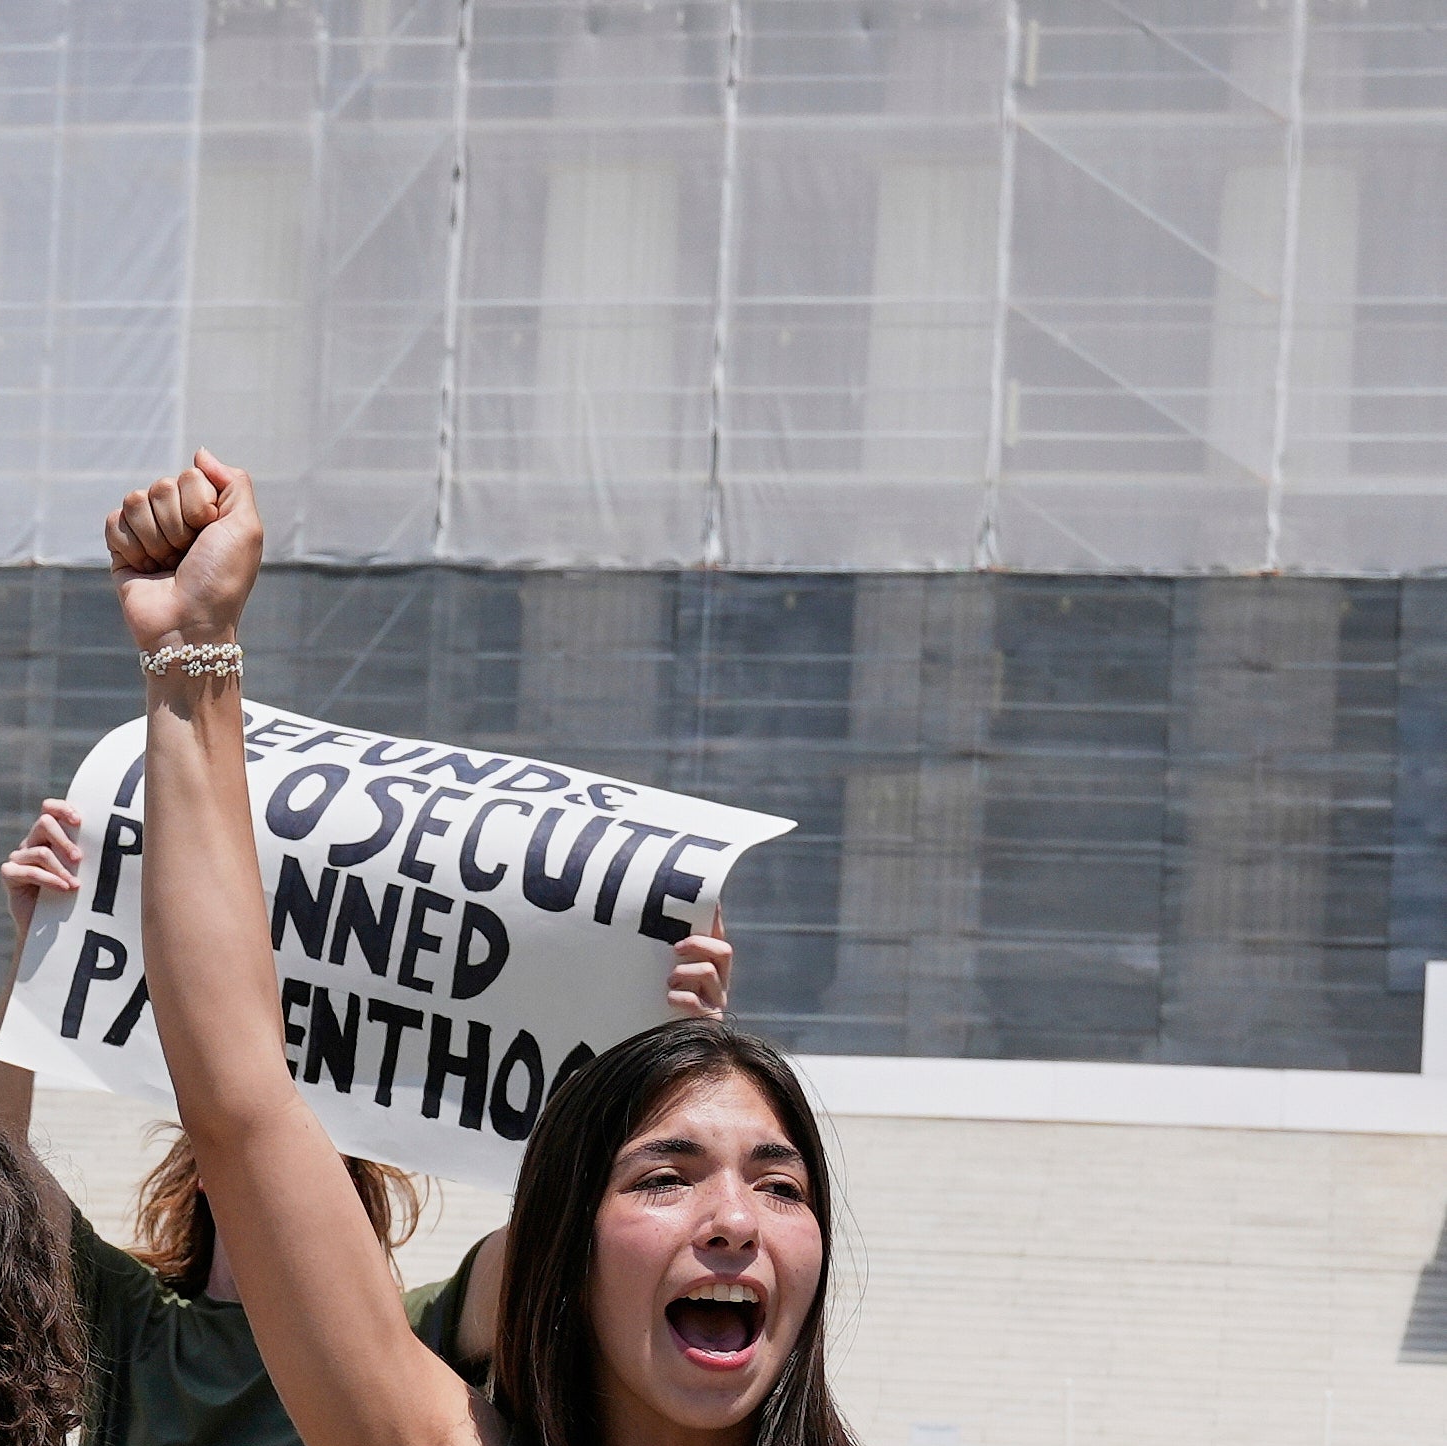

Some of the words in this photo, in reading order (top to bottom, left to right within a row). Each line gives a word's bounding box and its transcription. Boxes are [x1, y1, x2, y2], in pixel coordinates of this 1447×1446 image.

[242, 710, 570, 793] EFUND
[90, 813, 510, 1000] PNNED
[113, 748, 733, 946] OSECUTE
